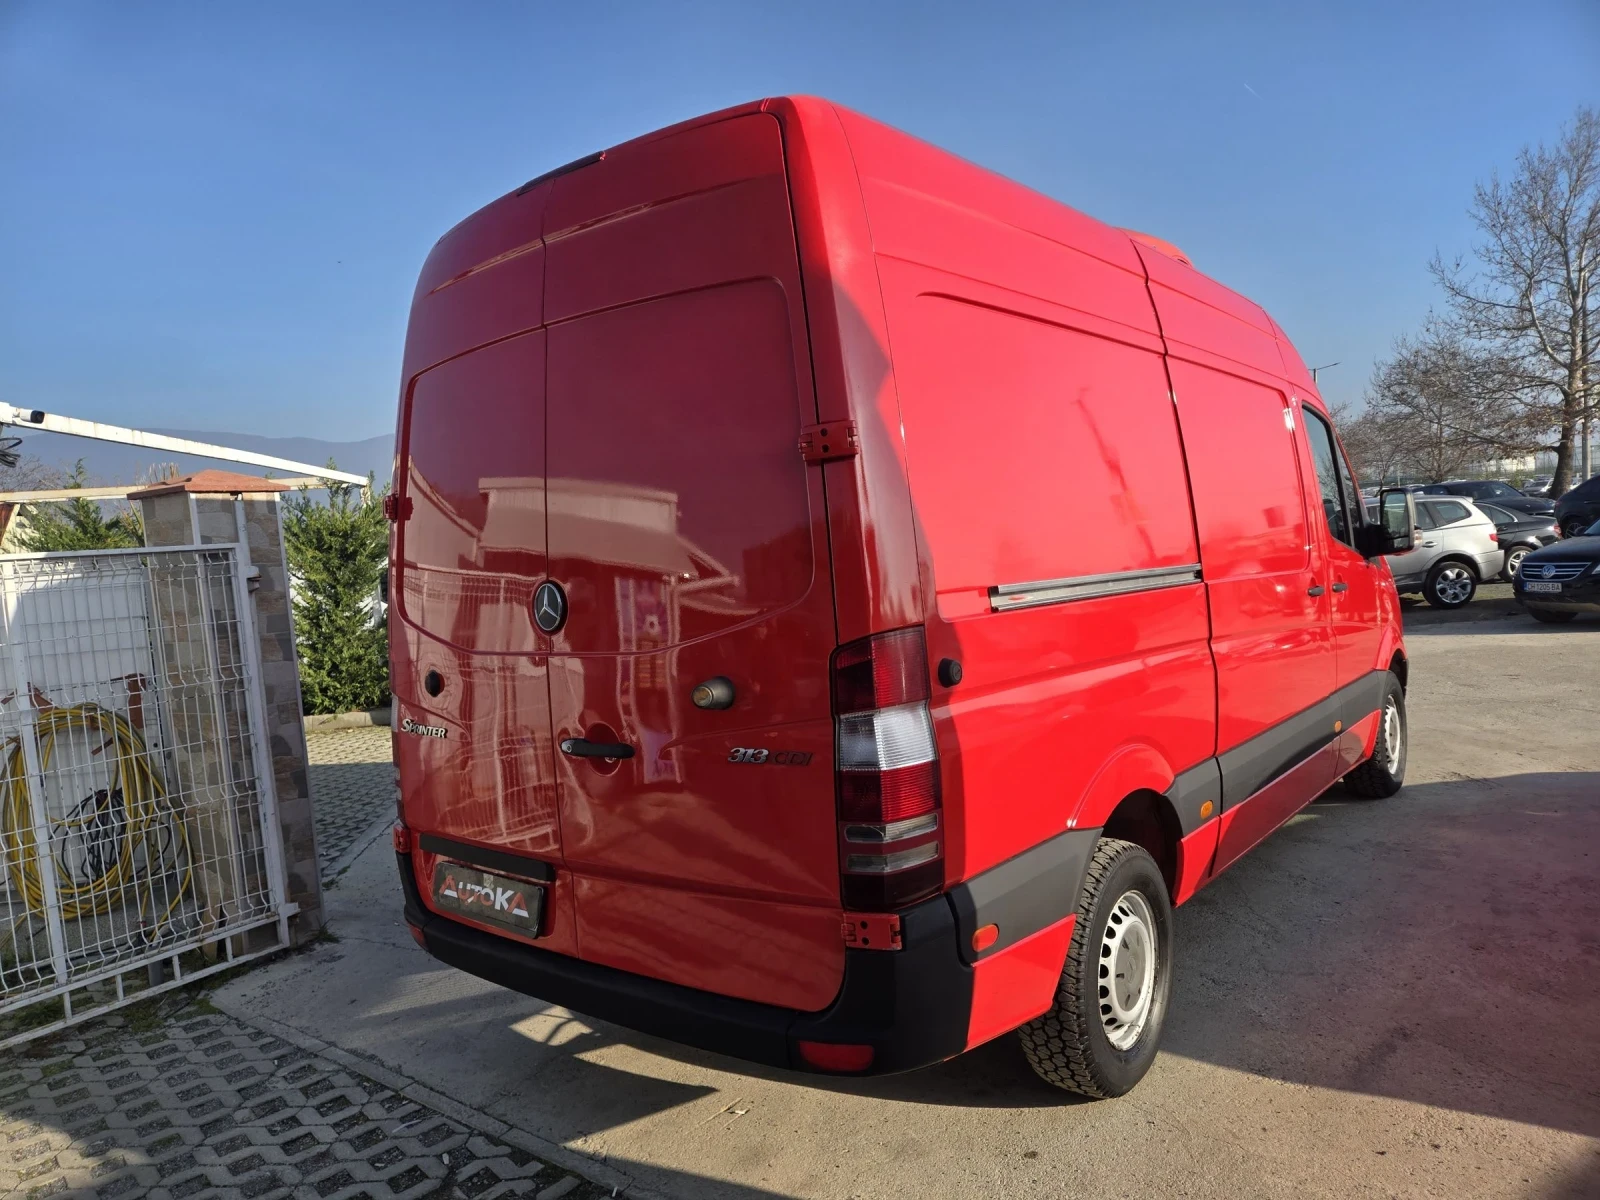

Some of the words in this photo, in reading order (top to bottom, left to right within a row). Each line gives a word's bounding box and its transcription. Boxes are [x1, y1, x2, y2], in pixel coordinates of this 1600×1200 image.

[400, 718, 448, 739] SPRINTER
[727, 747, 770, 764] 313
[773, 752, 813, 767] CDI
[438, 874, 530, 918] AUTOKA
